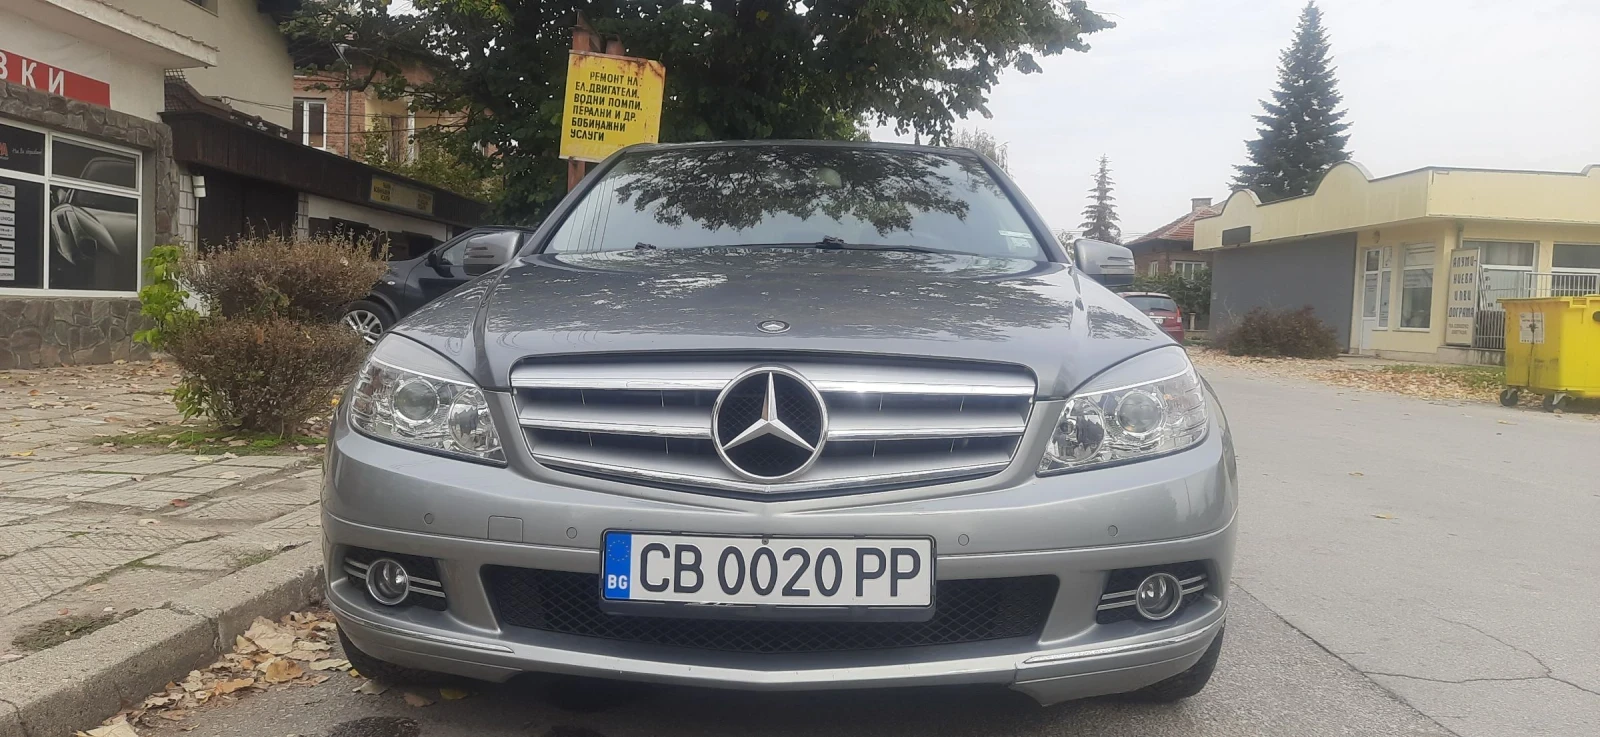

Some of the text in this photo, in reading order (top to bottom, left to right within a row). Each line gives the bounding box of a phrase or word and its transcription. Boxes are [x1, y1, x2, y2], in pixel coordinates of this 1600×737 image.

[590, 72, 624, 84] РЕМОНТ
[574, 94, 604, 106] ВОДНИ
[573, 106, 637, 122] ПЕРАЛНИ И ДР.
[572, 117, 626, 132] БОБИНАЖНИ
[570, 129, 604, 141] УСЛУГИ
[1448, 307, 1474, 318] ДОГРАМА
[640, 543, 921, 597] CB 0020 PP
[607, 574, 628, 590] BG
